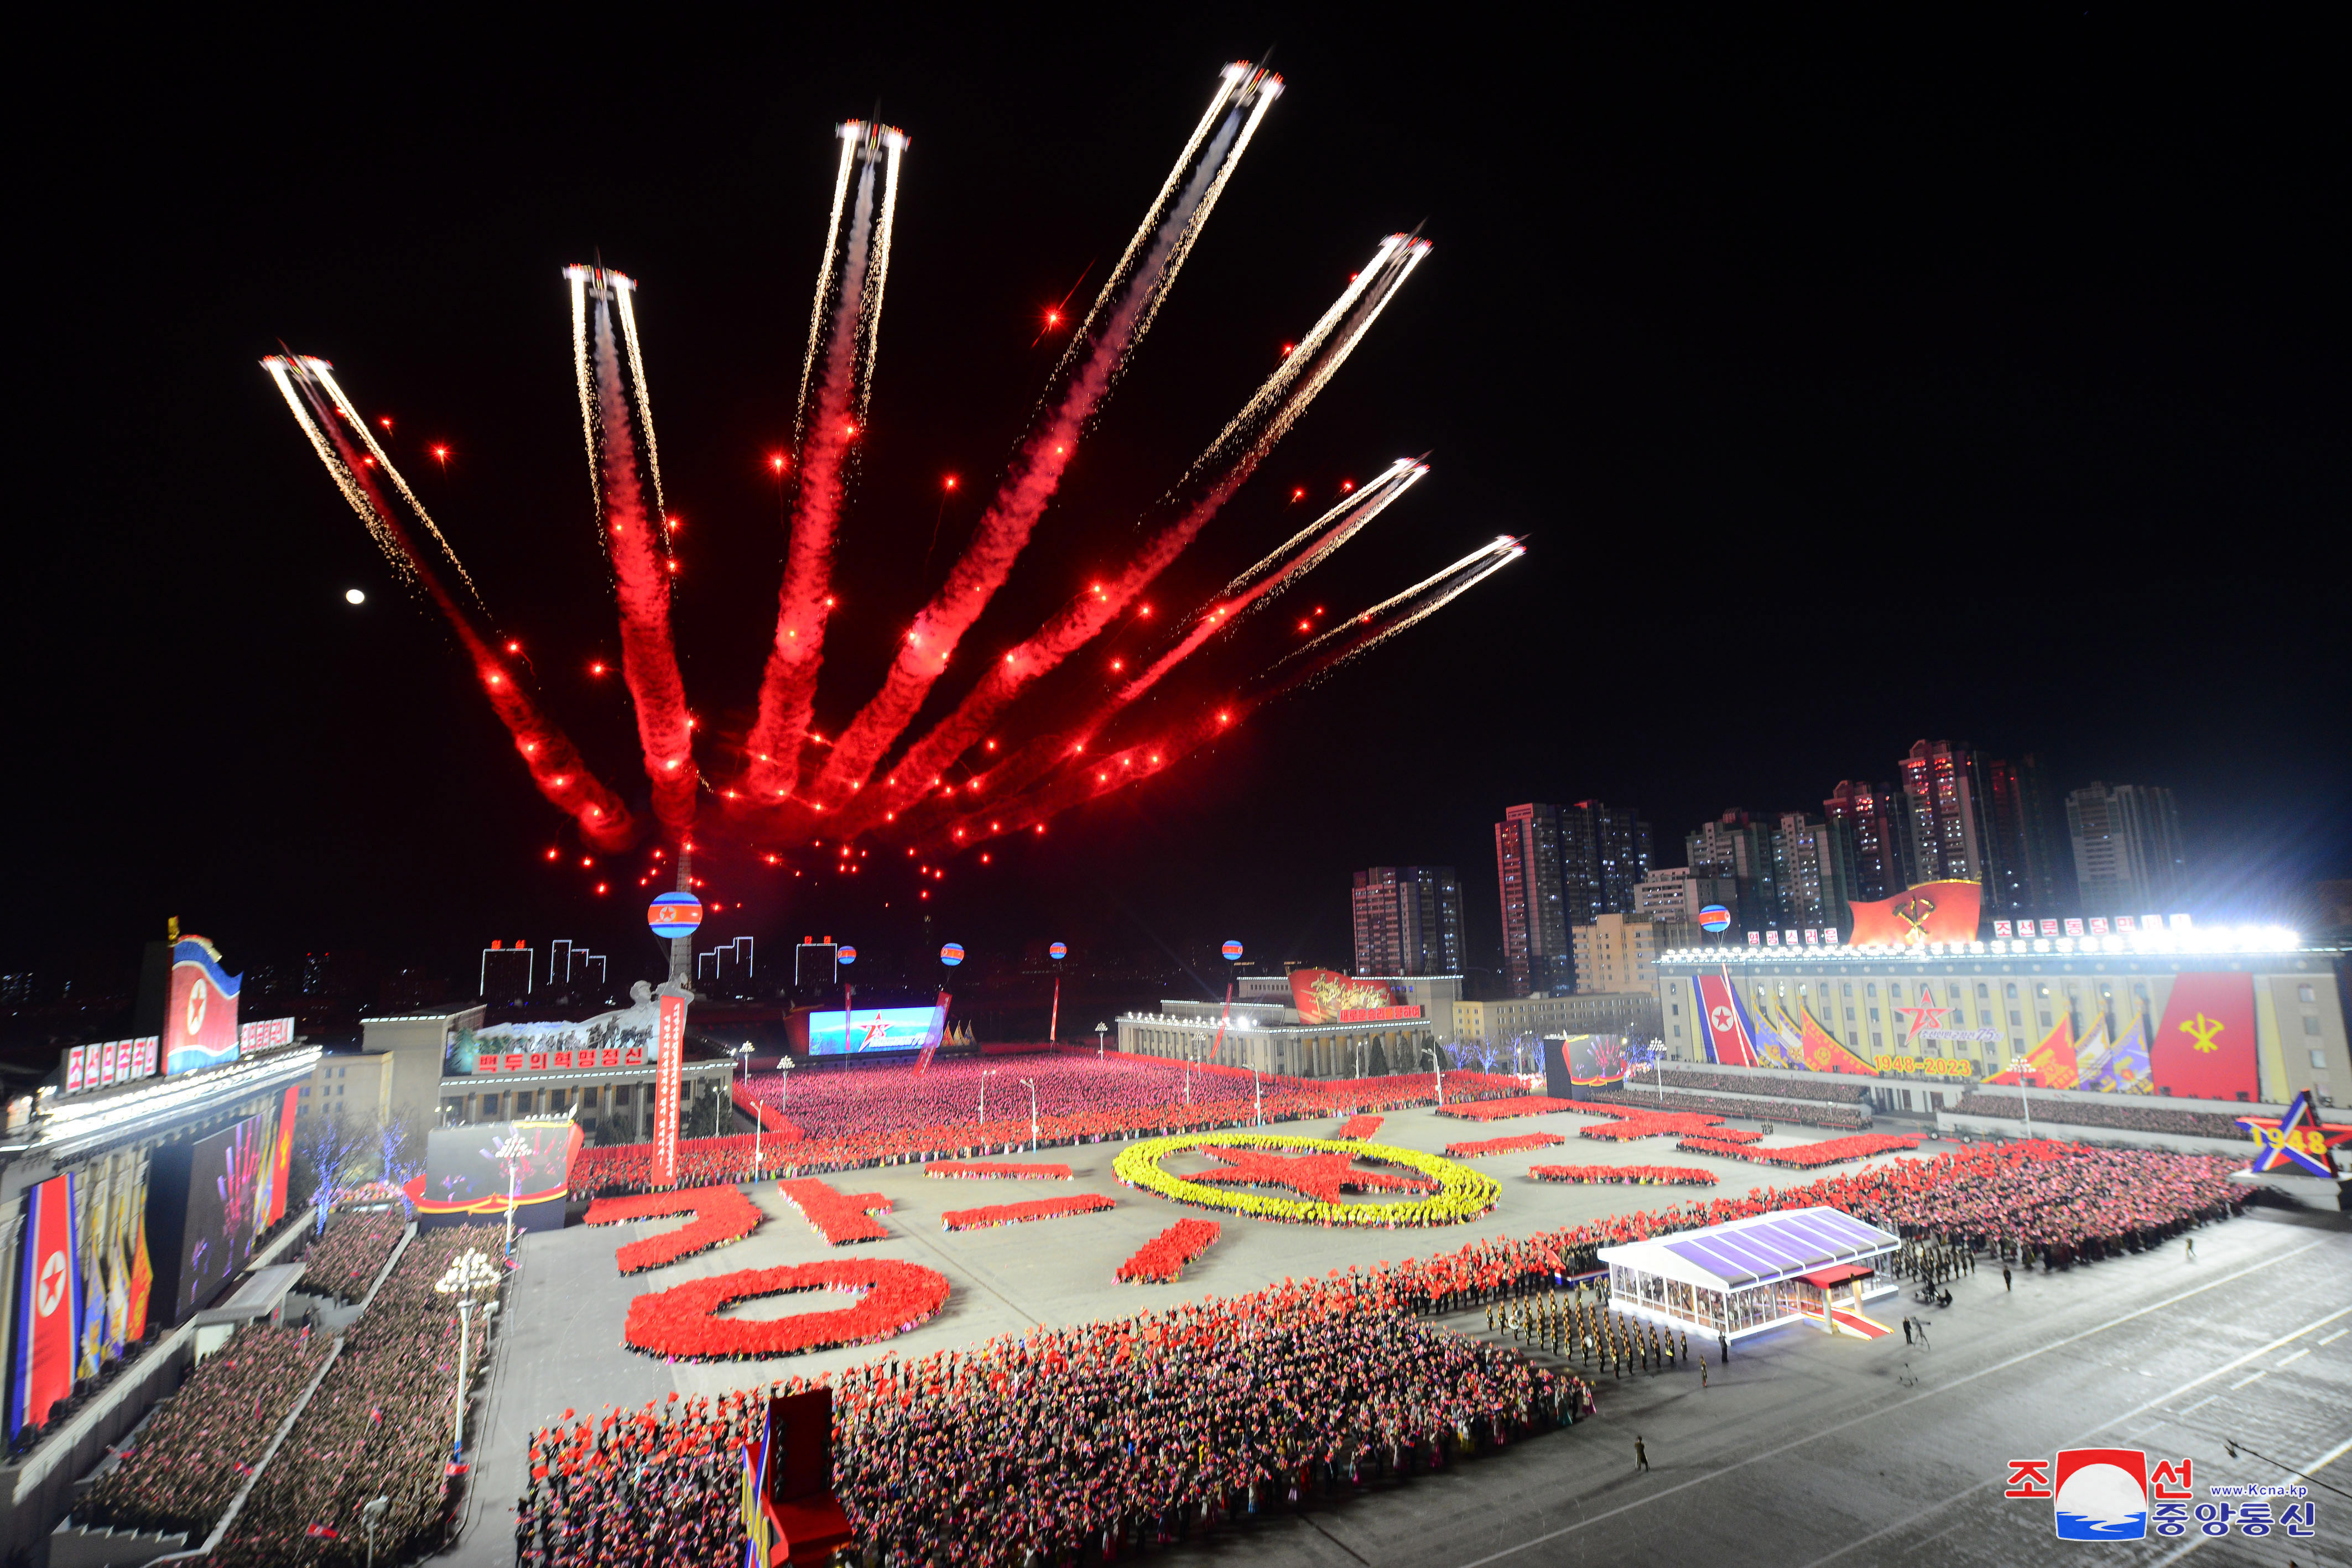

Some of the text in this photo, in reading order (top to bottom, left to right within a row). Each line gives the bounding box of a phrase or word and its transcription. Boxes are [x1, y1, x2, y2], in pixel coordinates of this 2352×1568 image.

[1749, 929, 1837, 945] 영광스러운
[1996, 919, 2106, 936] 조선로동당
[69, 1039, 156, 1090] 조선민주주의
[479, 1048, 643, 1074] 백두의 혁명정신
[1874, 1054, 1973, 1076] 1948-2023
[2251, 1127, 2328, 1155] 1948
